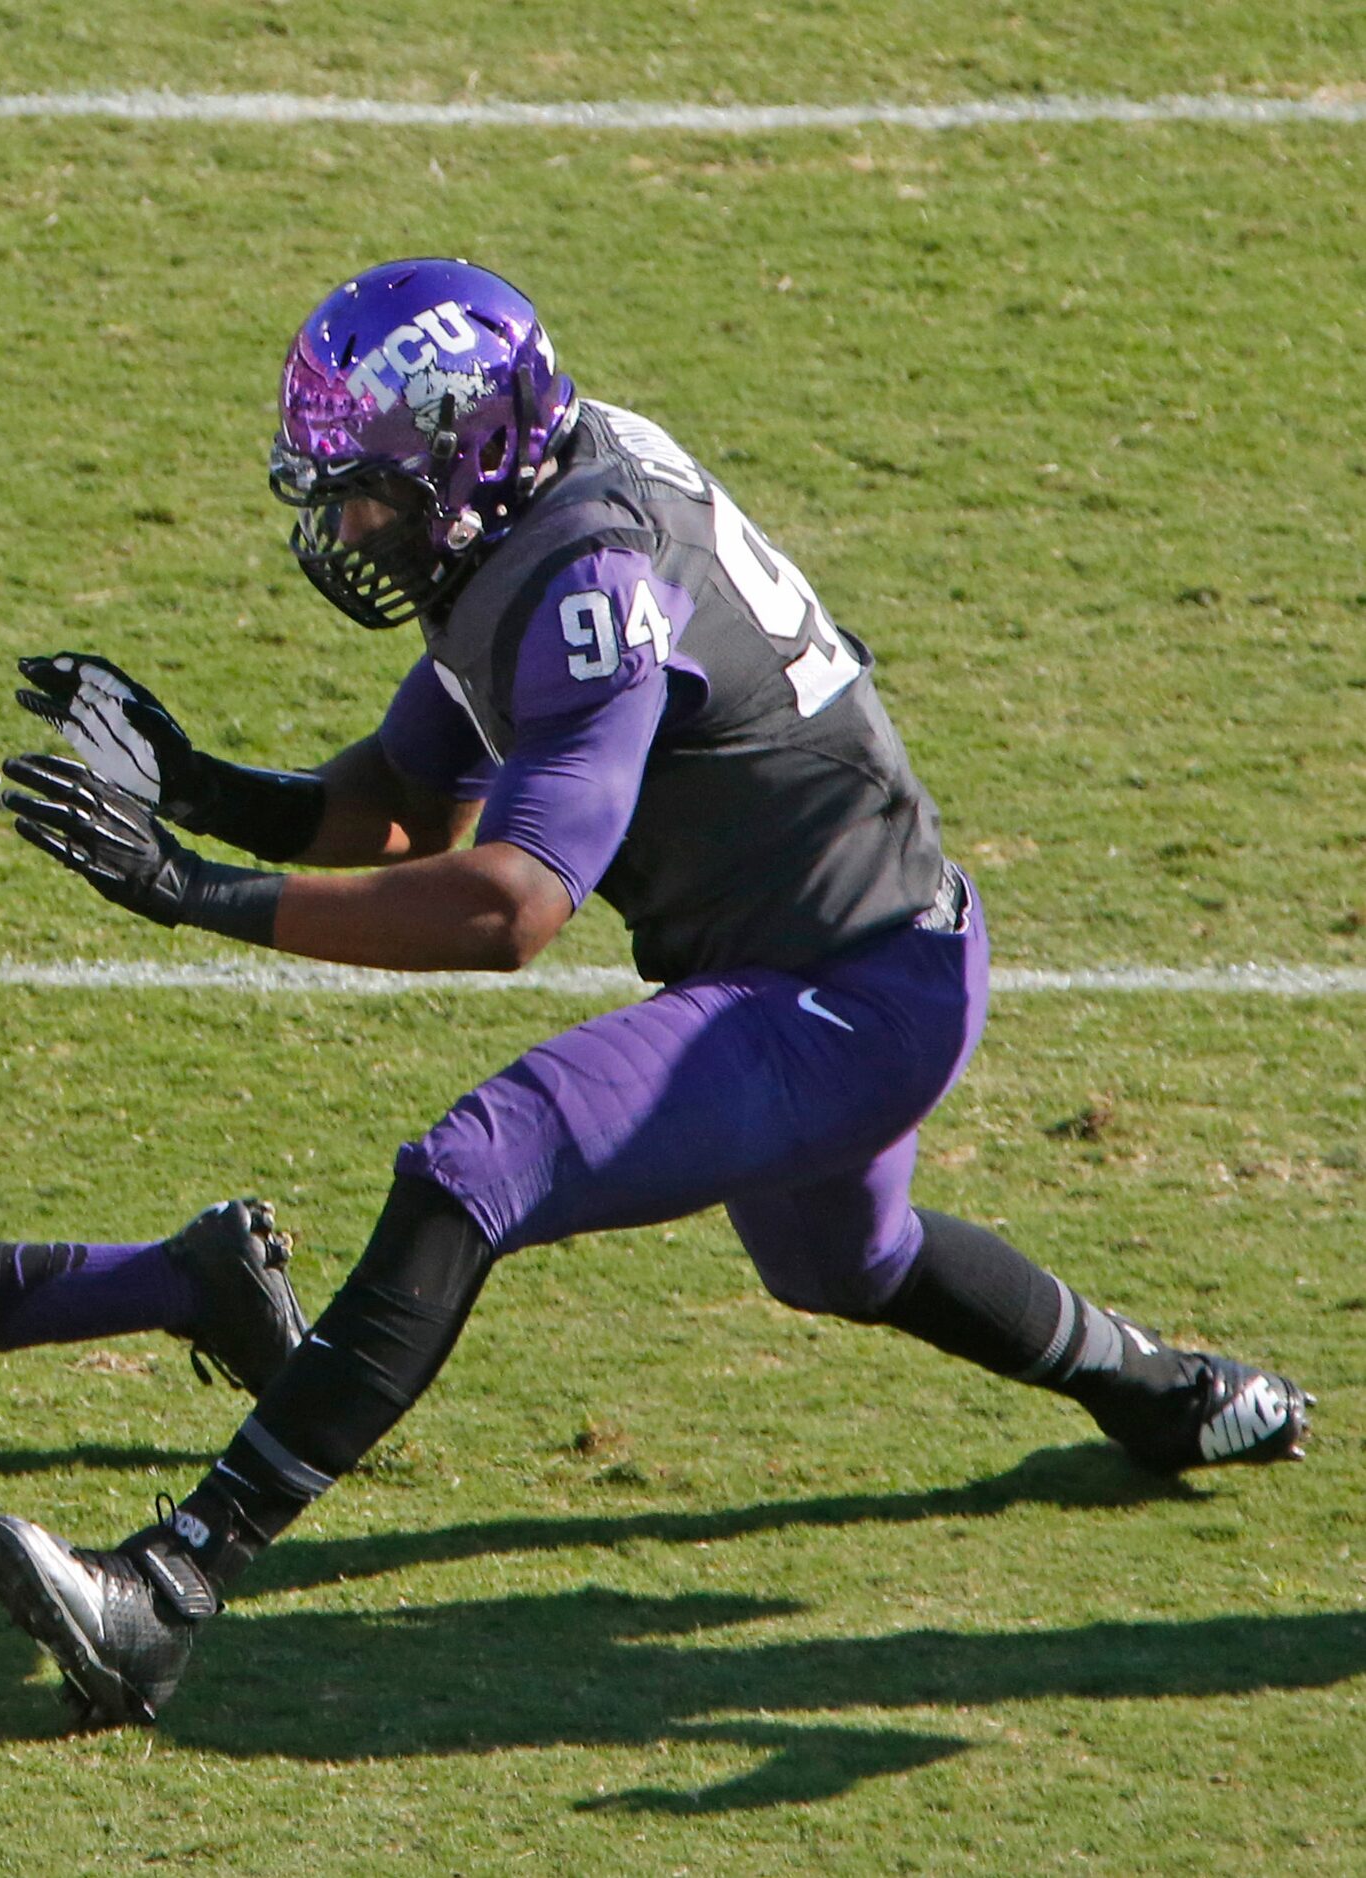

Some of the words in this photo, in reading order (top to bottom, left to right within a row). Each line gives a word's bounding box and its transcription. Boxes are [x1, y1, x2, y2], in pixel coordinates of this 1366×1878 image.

[346, 300, 477, 414] TCU
[559, 579, 673, 682] 94
[1199, 1375, 1288, 1462] NIKE
